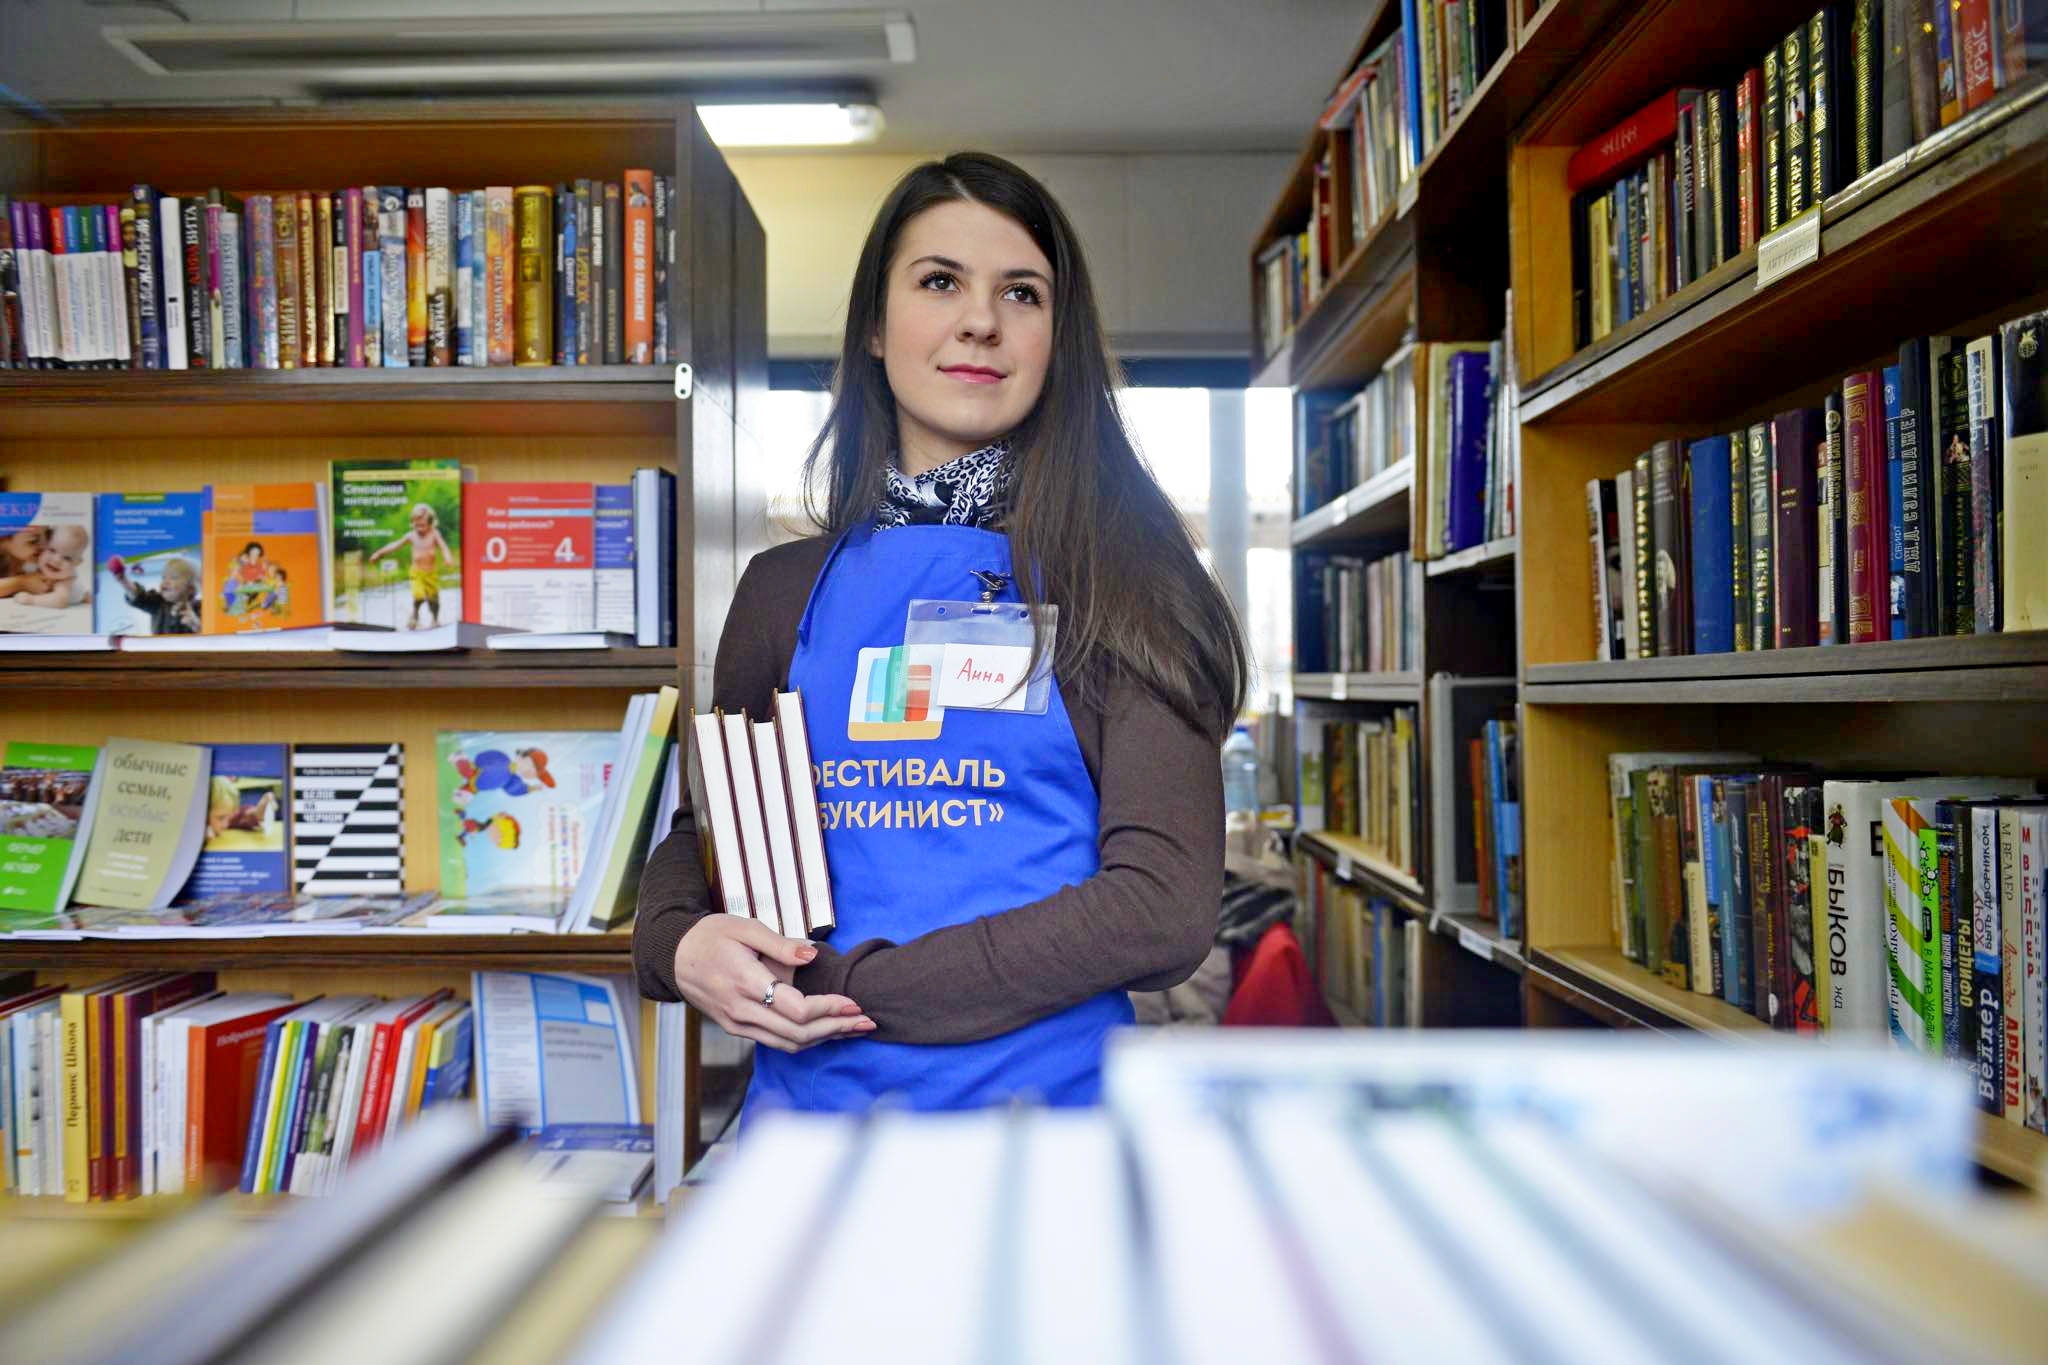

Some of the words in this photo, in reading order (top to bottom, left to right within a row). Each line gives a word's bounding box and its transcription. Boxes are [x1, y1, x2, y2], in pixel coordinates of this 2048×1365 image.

[1972, 21, 1990, 86] КРЫС
[191, 323, 202, 355] Андрей
[1900, 407, 1920, 522] СЭЛИНДЖЕР
[486, 536, 507, 563] 0
[555, 536, 575, 563] 4
[957, 658, 1005, 684] Анна
[113, 753, 188, 777] обычные
[117, 782, 173, 800] семьи,
[114, 828, 153, 845] дети
[1982, 824, 1993, 908] ДВОРНИКОМ
[1828, 867, 1848, 976] БЫКОВ
[1974, 891, 1985, 947] ХОЧУ
[1984, 914, 1993, 951] БЫТЬ
[2022, 855, 2035, 979] ВЕЛЛЕР
[1958, 918, 1973, 1008] ОФИЦЕРЫ
[65, 1022, 77, 1067] Школа
[1979, 988, 2000, 1101] Веллер
[2005, 1015, 2020, 1107] АРБАТА
